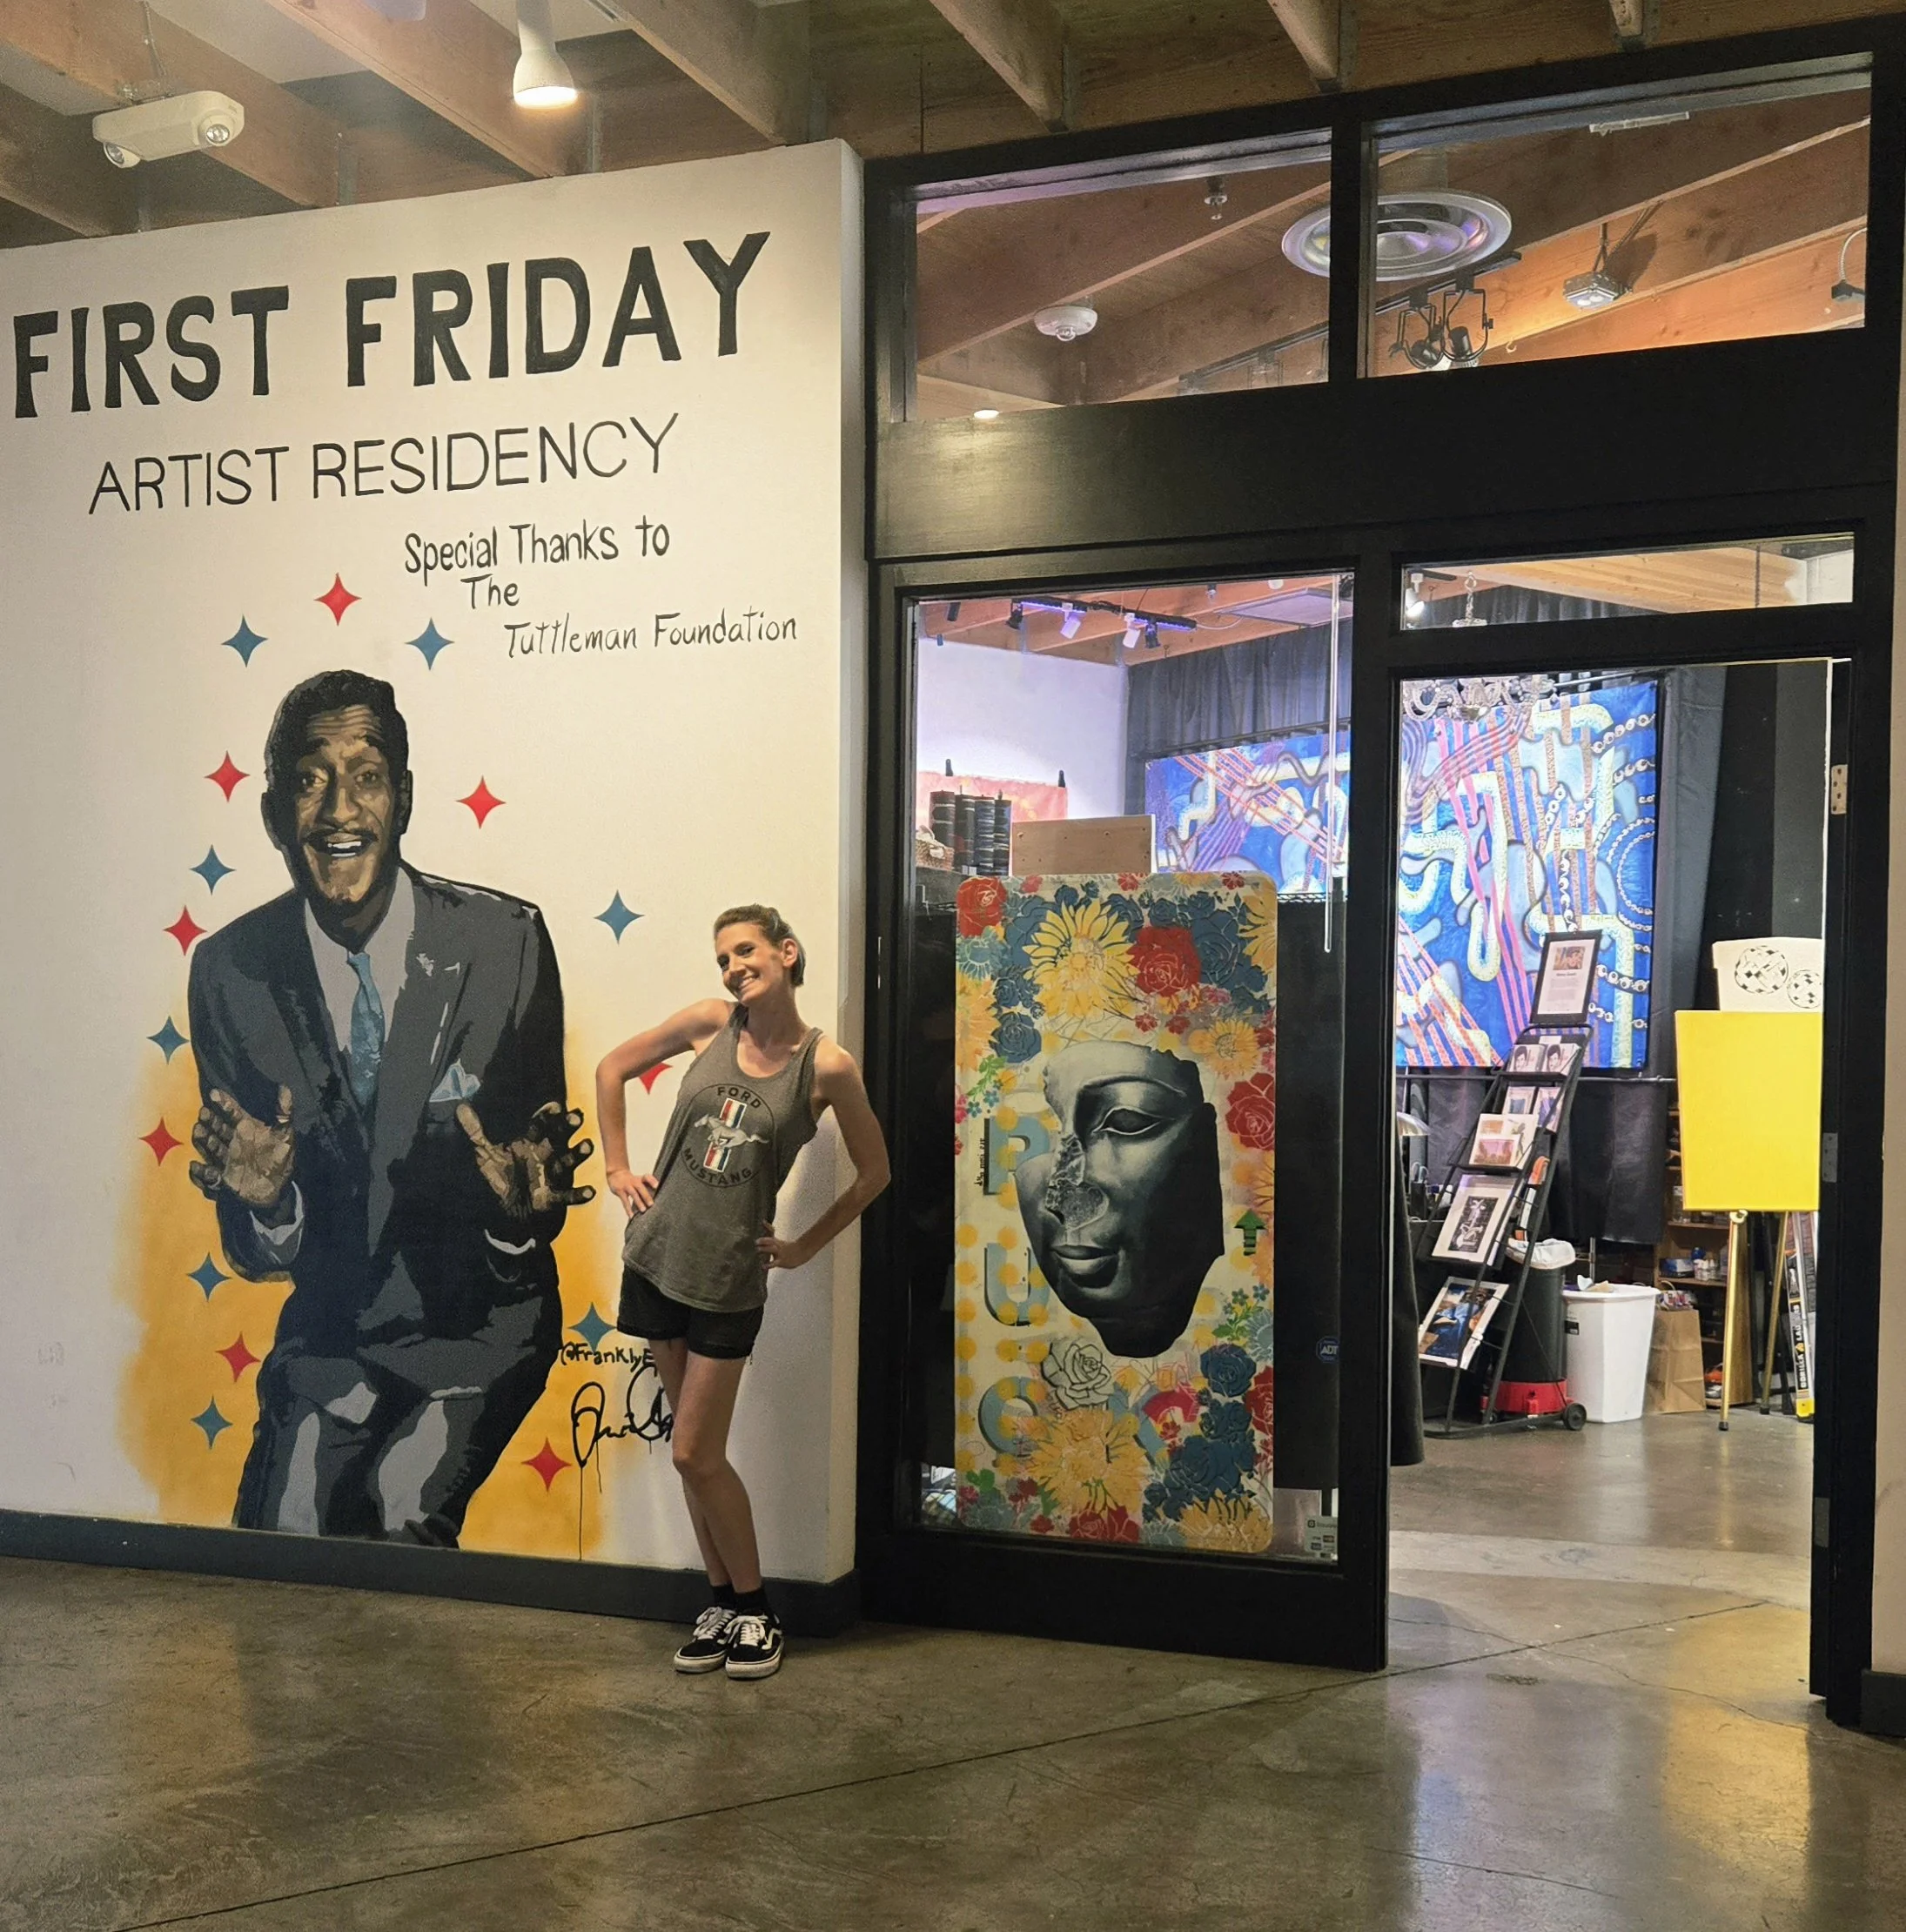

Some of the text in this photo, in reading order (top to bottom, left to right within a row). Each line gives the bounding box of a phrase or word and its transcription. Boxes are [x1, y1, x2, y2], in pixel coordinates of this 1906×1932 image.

[13, 231, 771, 419] FIRST FRIDAY
[89, 412, 680, 515] ARTIST RESIDENCY
[404, 514, 670, 587] Special Thanks to
[460, 573, 520, 610] The
[503, 606, 798, 659] Tuttleman Foundation
[716, 1085, 762, 1110] FORD
[683, 1147, 752, 1185] MUSTANG
